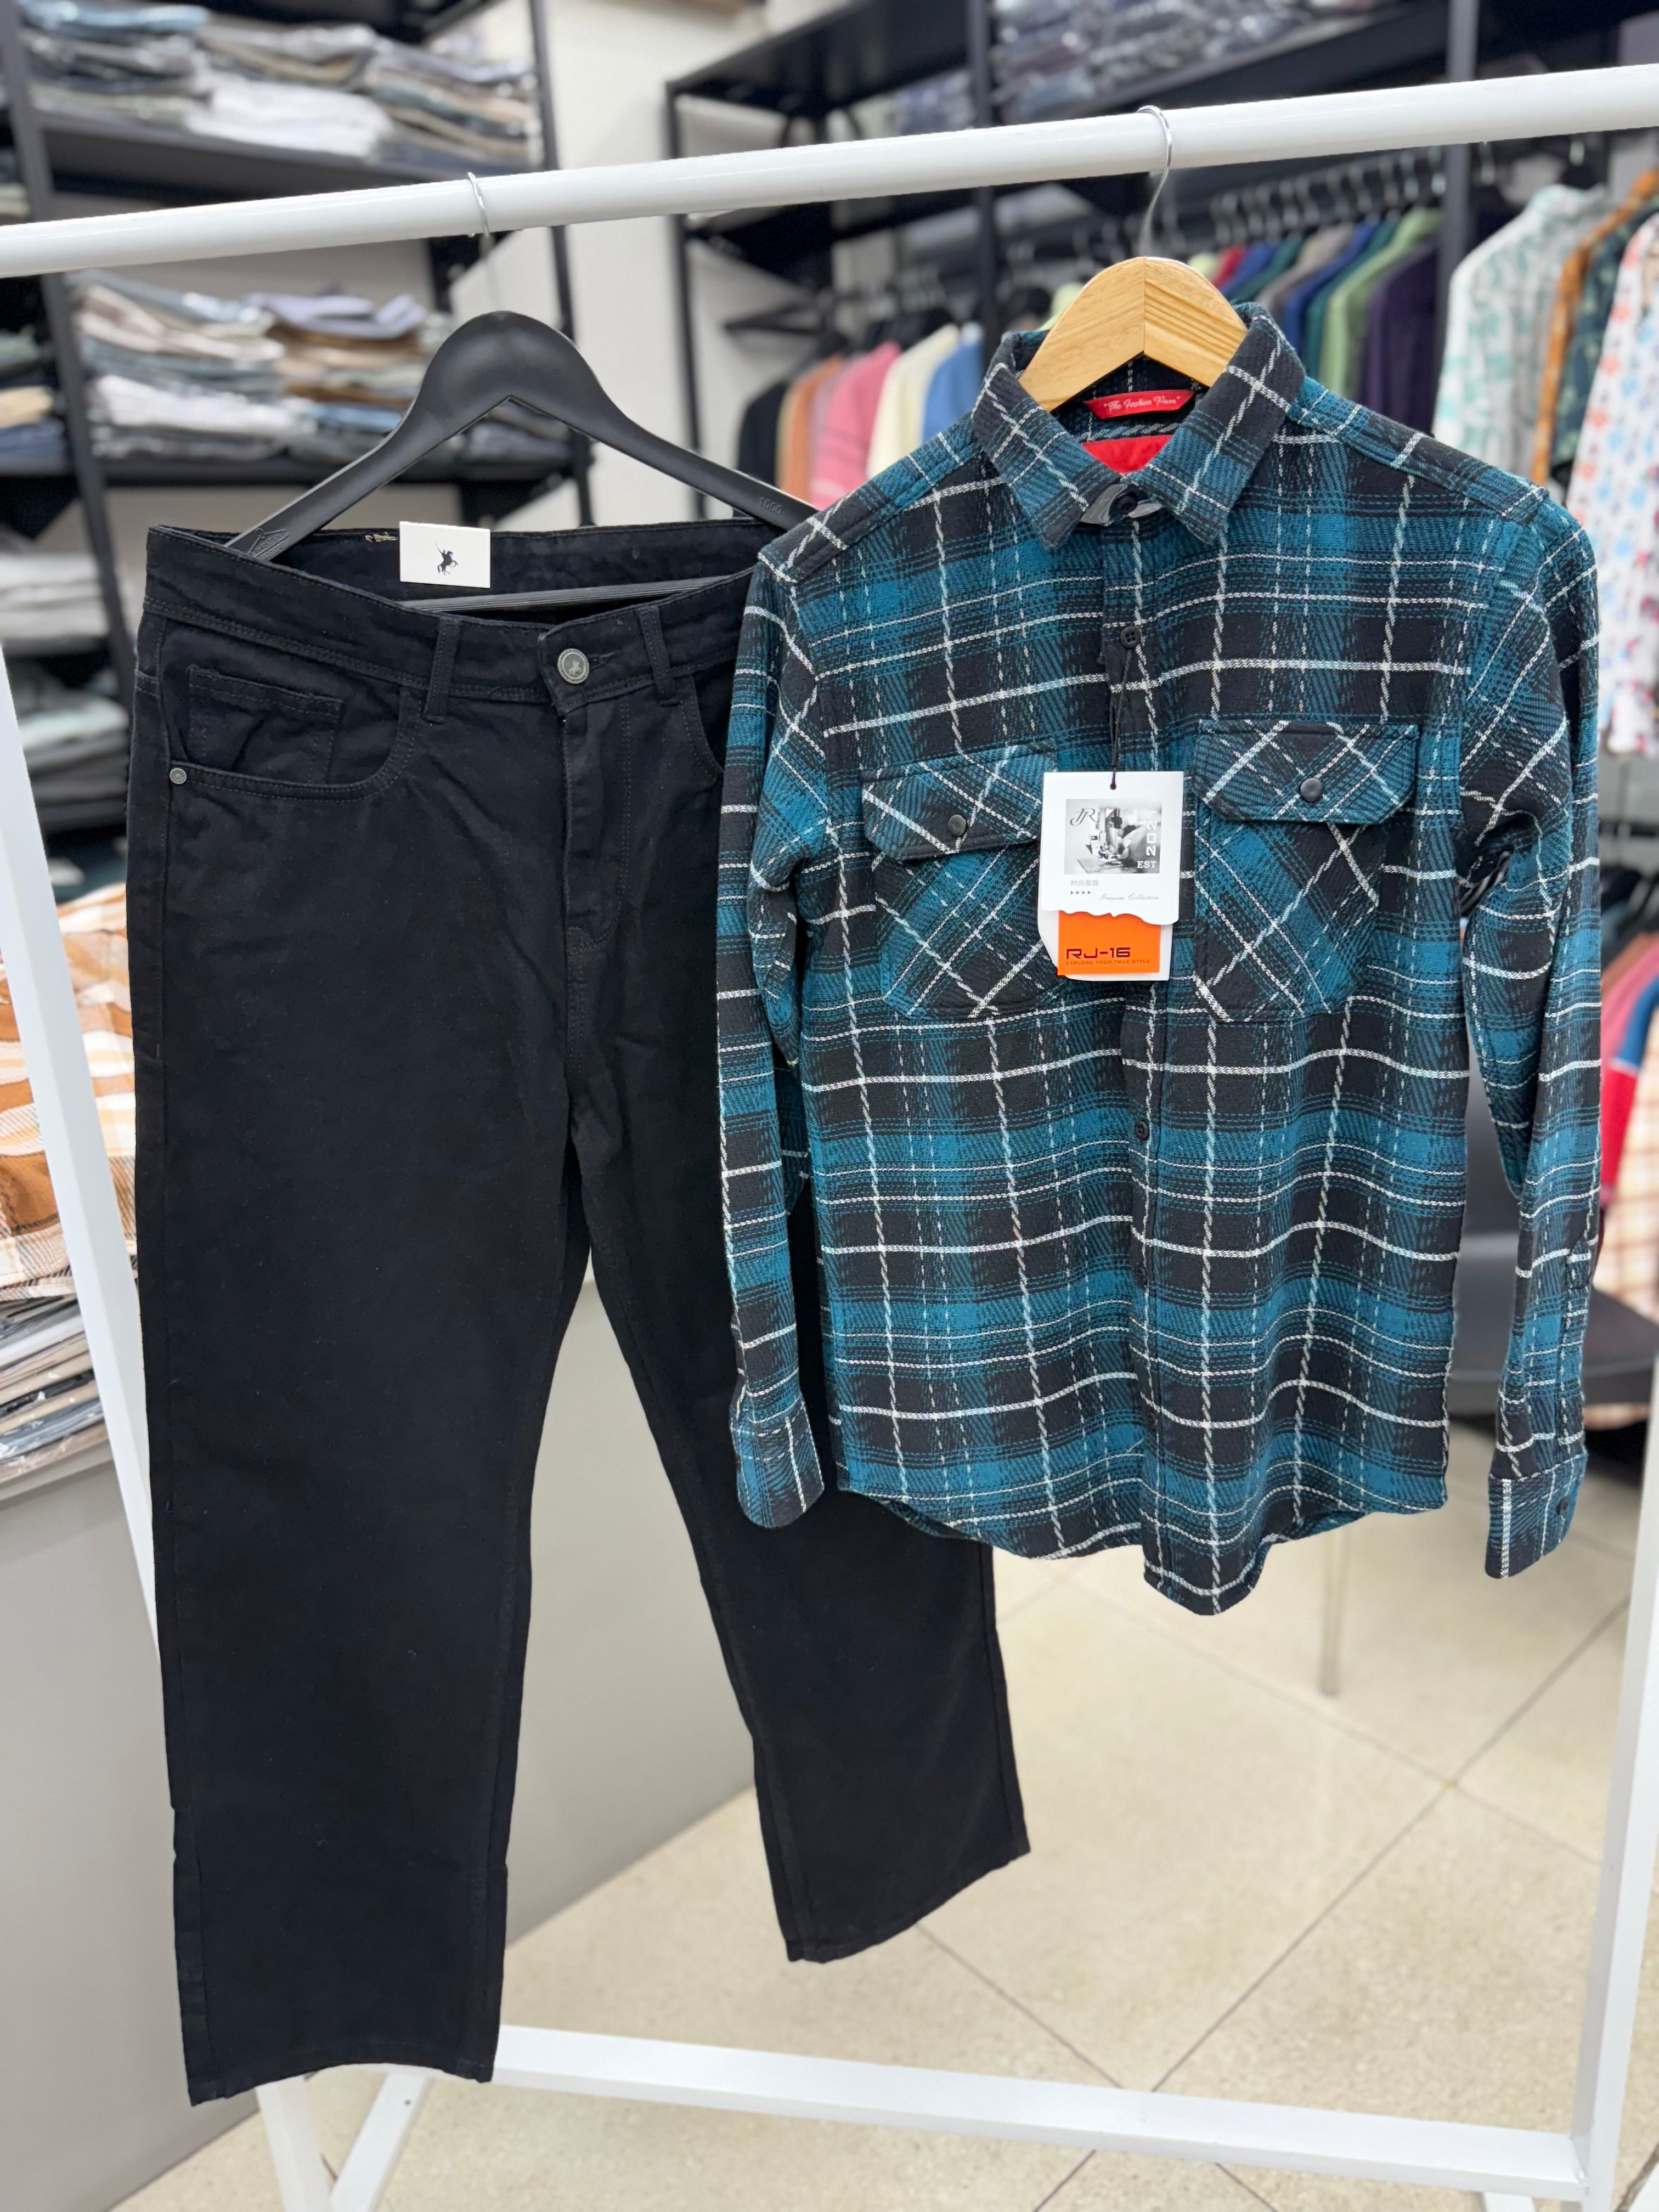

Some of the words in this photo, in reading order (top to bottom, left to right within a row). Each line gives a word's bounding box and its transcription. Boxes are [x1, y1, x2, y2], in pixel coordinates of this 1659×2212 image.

[1124, 398, 1152, 409] Fashion
[1137, 860, 1156, 869] EST
[1098, 892, 1125, 901] Genuine
[1127, 892, 1159, 900] Collection
[1066, 947, 1131, 959] RJ-16
